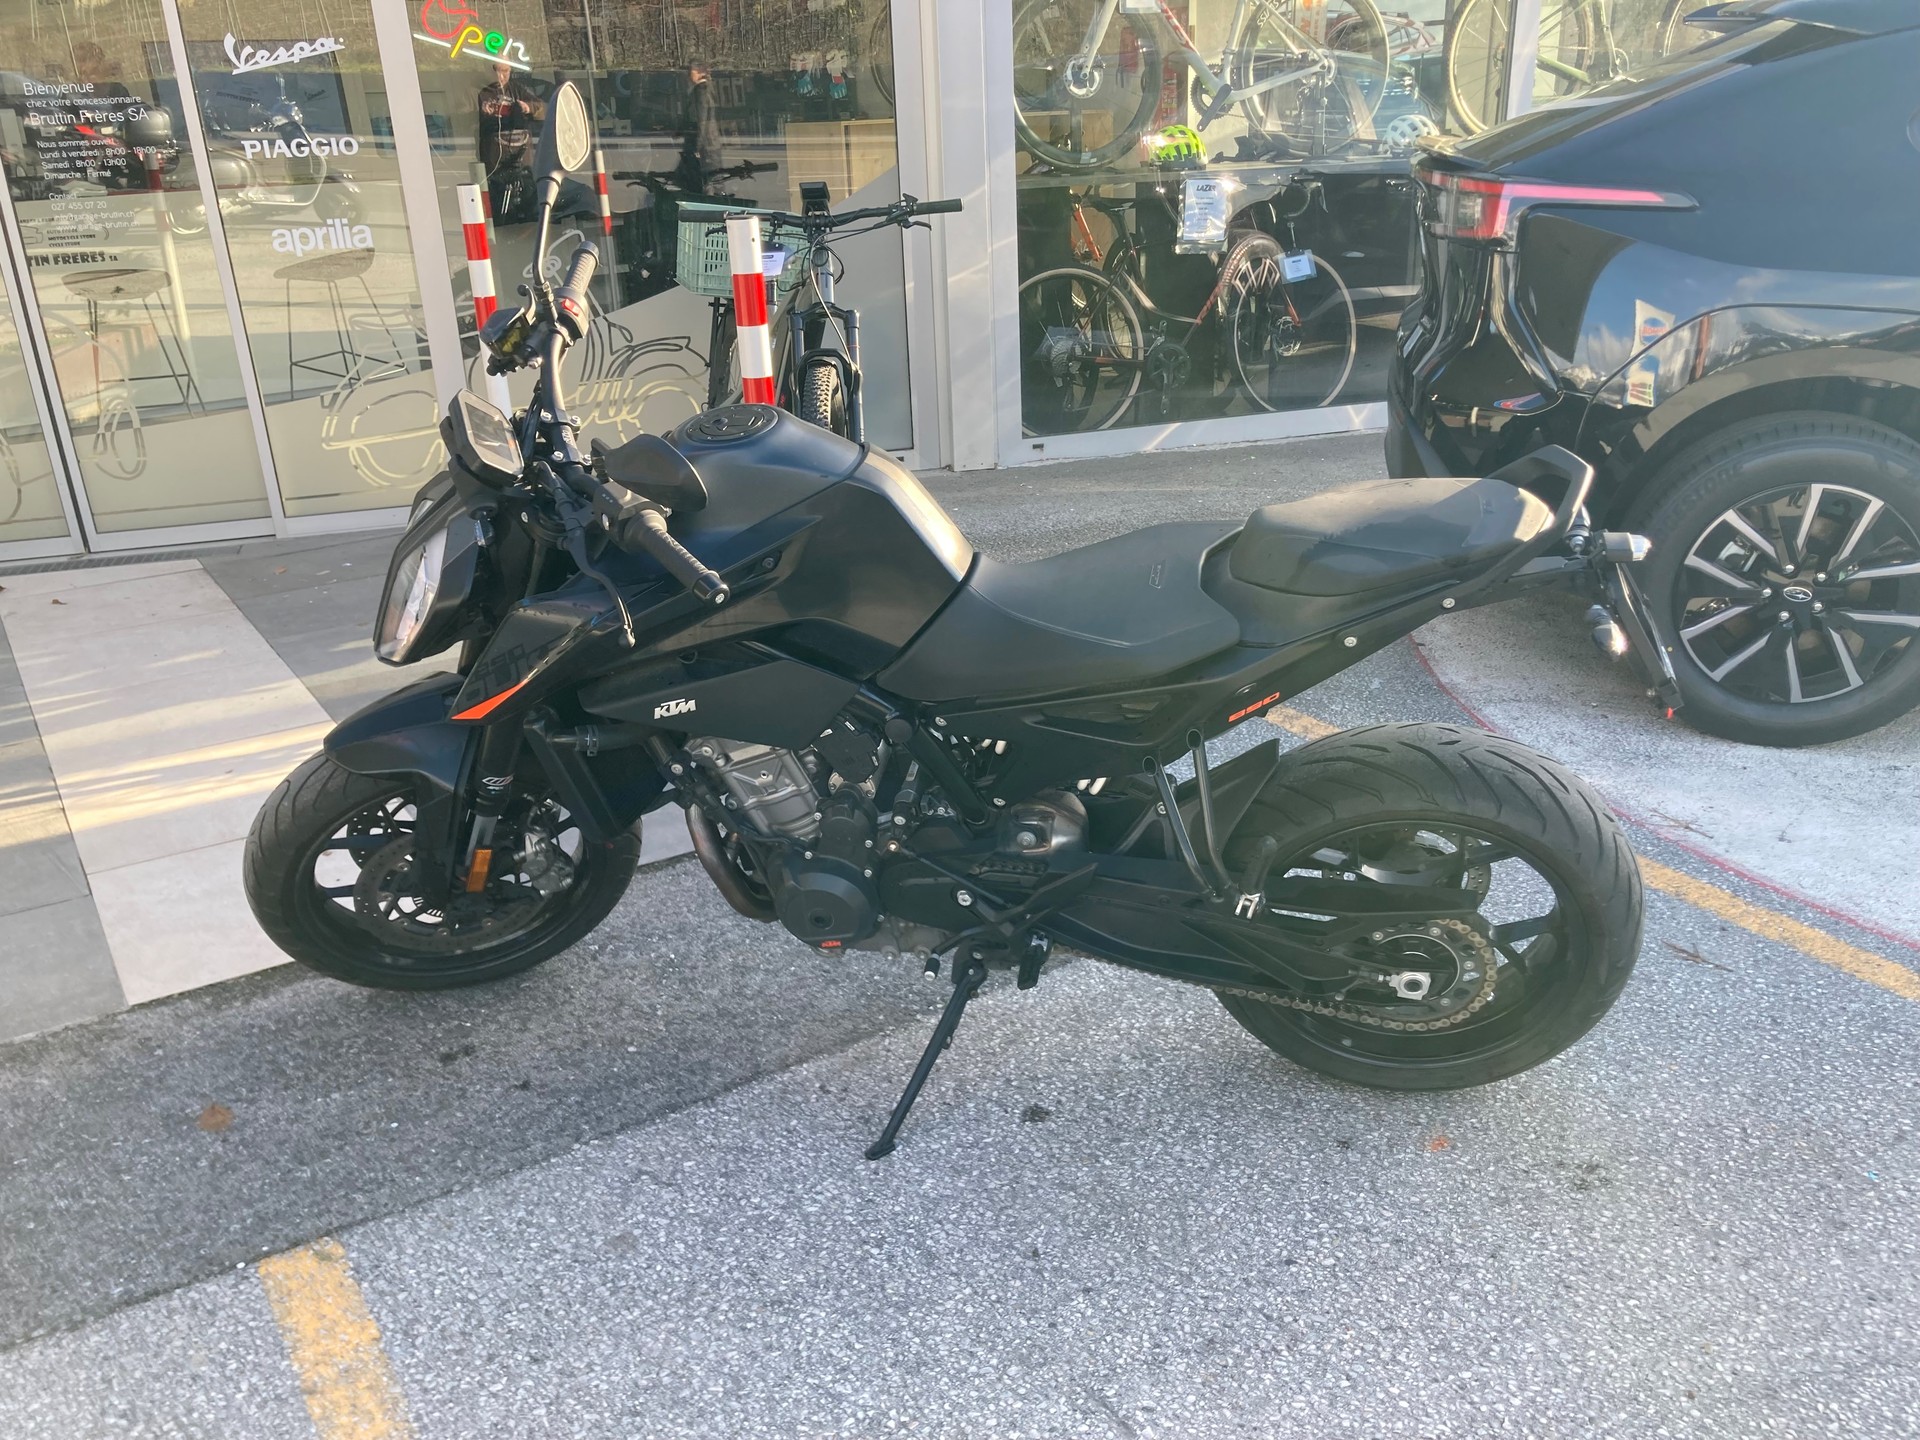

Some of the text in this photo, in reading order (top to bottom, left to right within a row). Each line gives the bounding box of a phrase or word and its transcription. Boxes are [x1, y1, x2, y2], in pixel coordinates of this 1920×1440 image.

[421, 0, 530, 60] Open
[224, 33, 345, 75] Vespa
[23, 82, 95, 96] Bienvenue
[26, 96, 141, 108] chez votre concessionnaire
[29, 107, 150, 126] Bruttin Frères SA
[36, 140, 57, 148] Nous
[58, 140, 90, 148] sommes
[241, 137, 359, 159] PIAGGIO
[38, 150, 60, 159] Lundi
[61, 150, 67, 158] à
[67, 149, 100, 158] vendredi
[105, 147, 126, 156] 8h00
[132, 146, 157, 154] 18h00
[41, 160, 70, 170] Samedi
[75, 160, 96, 168] 8h00
[103, 157, 127, 167] 13h00
[43, 170, 81, 180] Dimanche
[87, 169, 112, 178] Fermé
[51, 200, 107, 211] 027 455 07 20
[271, 218, 374, 257] aprilia
[52, 251, 106, 266] FRERES
[654, 698, 697, 720] KTM
